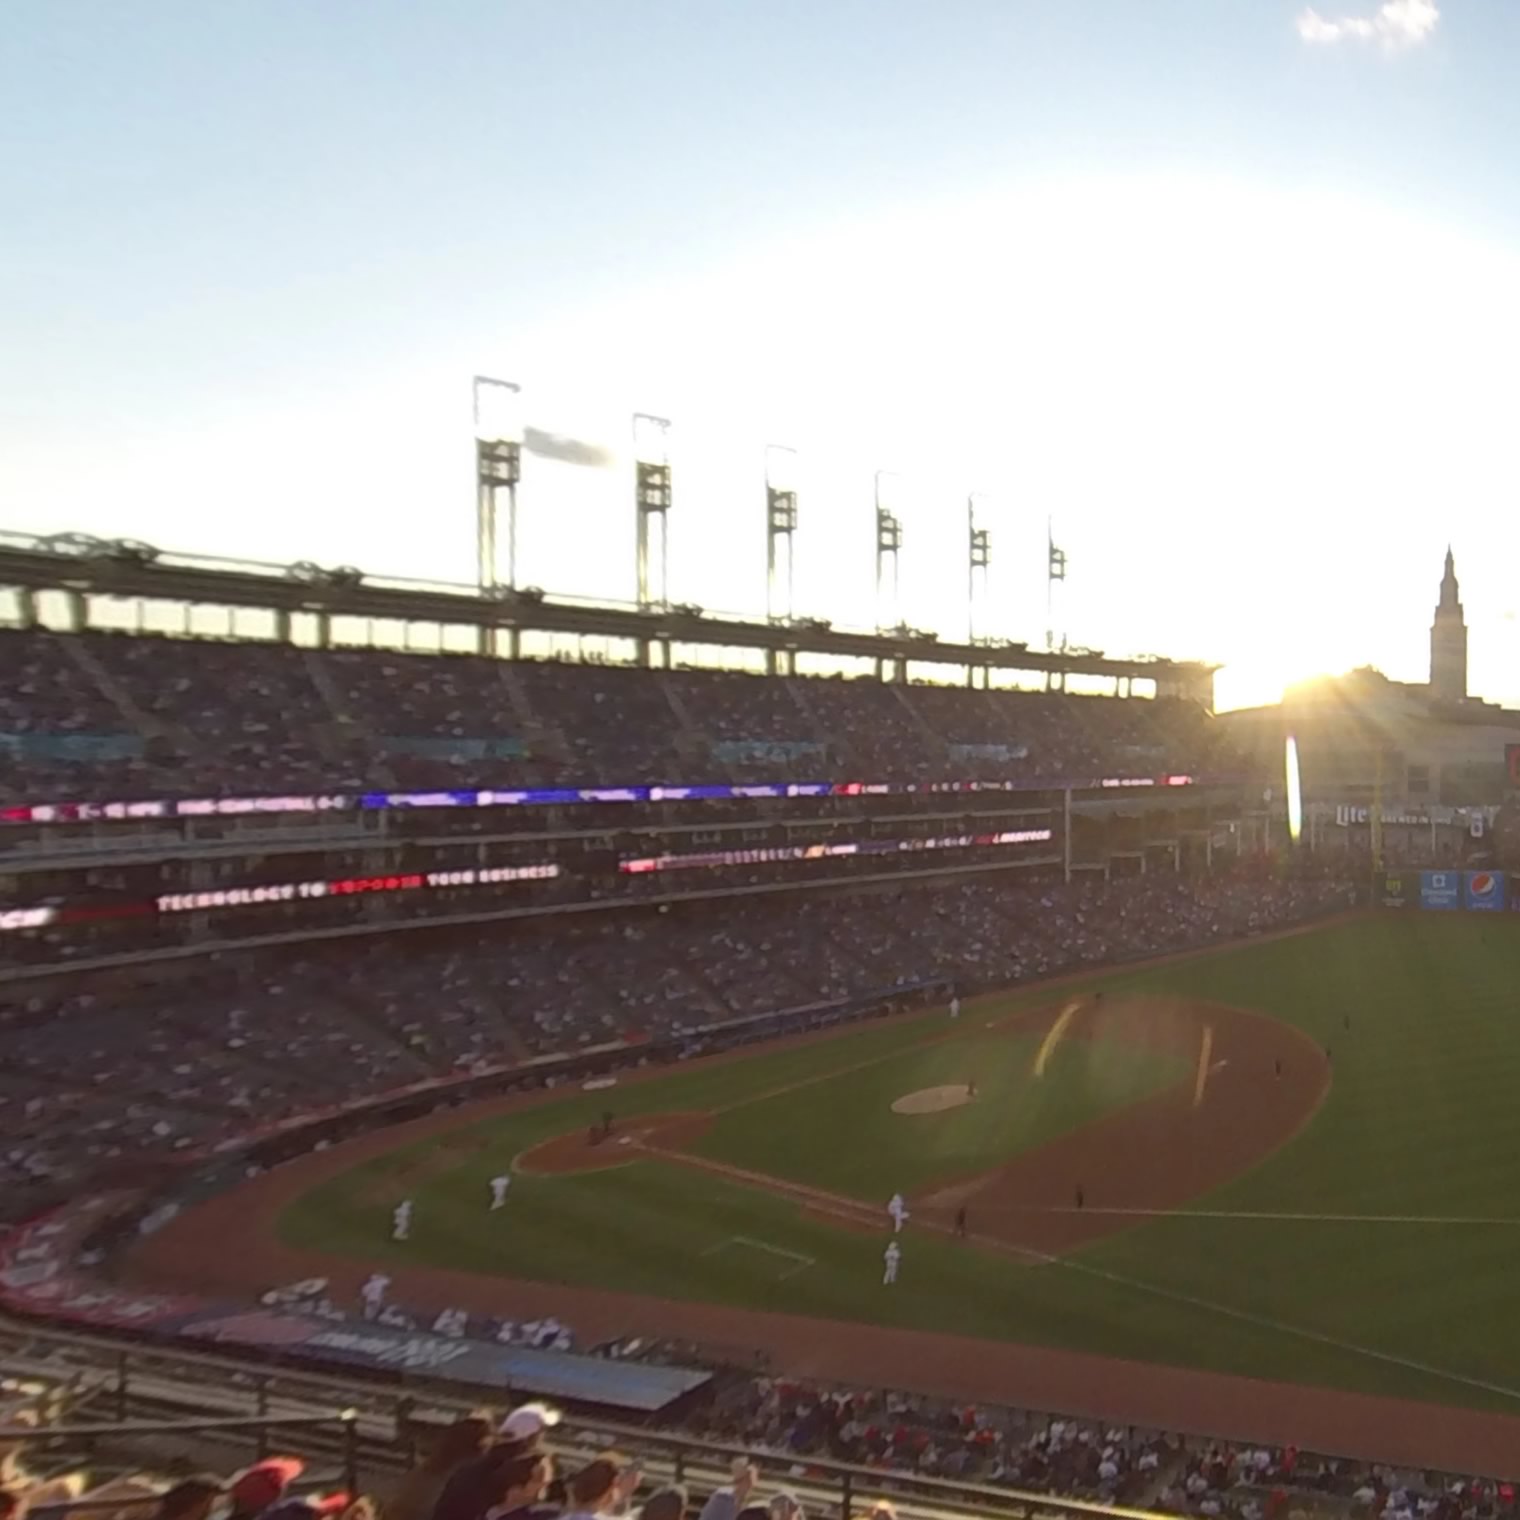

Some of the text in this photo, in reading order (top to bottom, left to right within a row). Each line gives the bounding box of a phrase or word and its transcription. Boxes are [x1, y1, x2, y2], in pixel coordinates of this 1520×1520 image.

[1336, 805, 1368, 827] Lite
[158, 883, 294, 912] TECHNOLOGY
[299, 881, 326, 898] TO
[479, 864, 559, 883] BUSINESS
